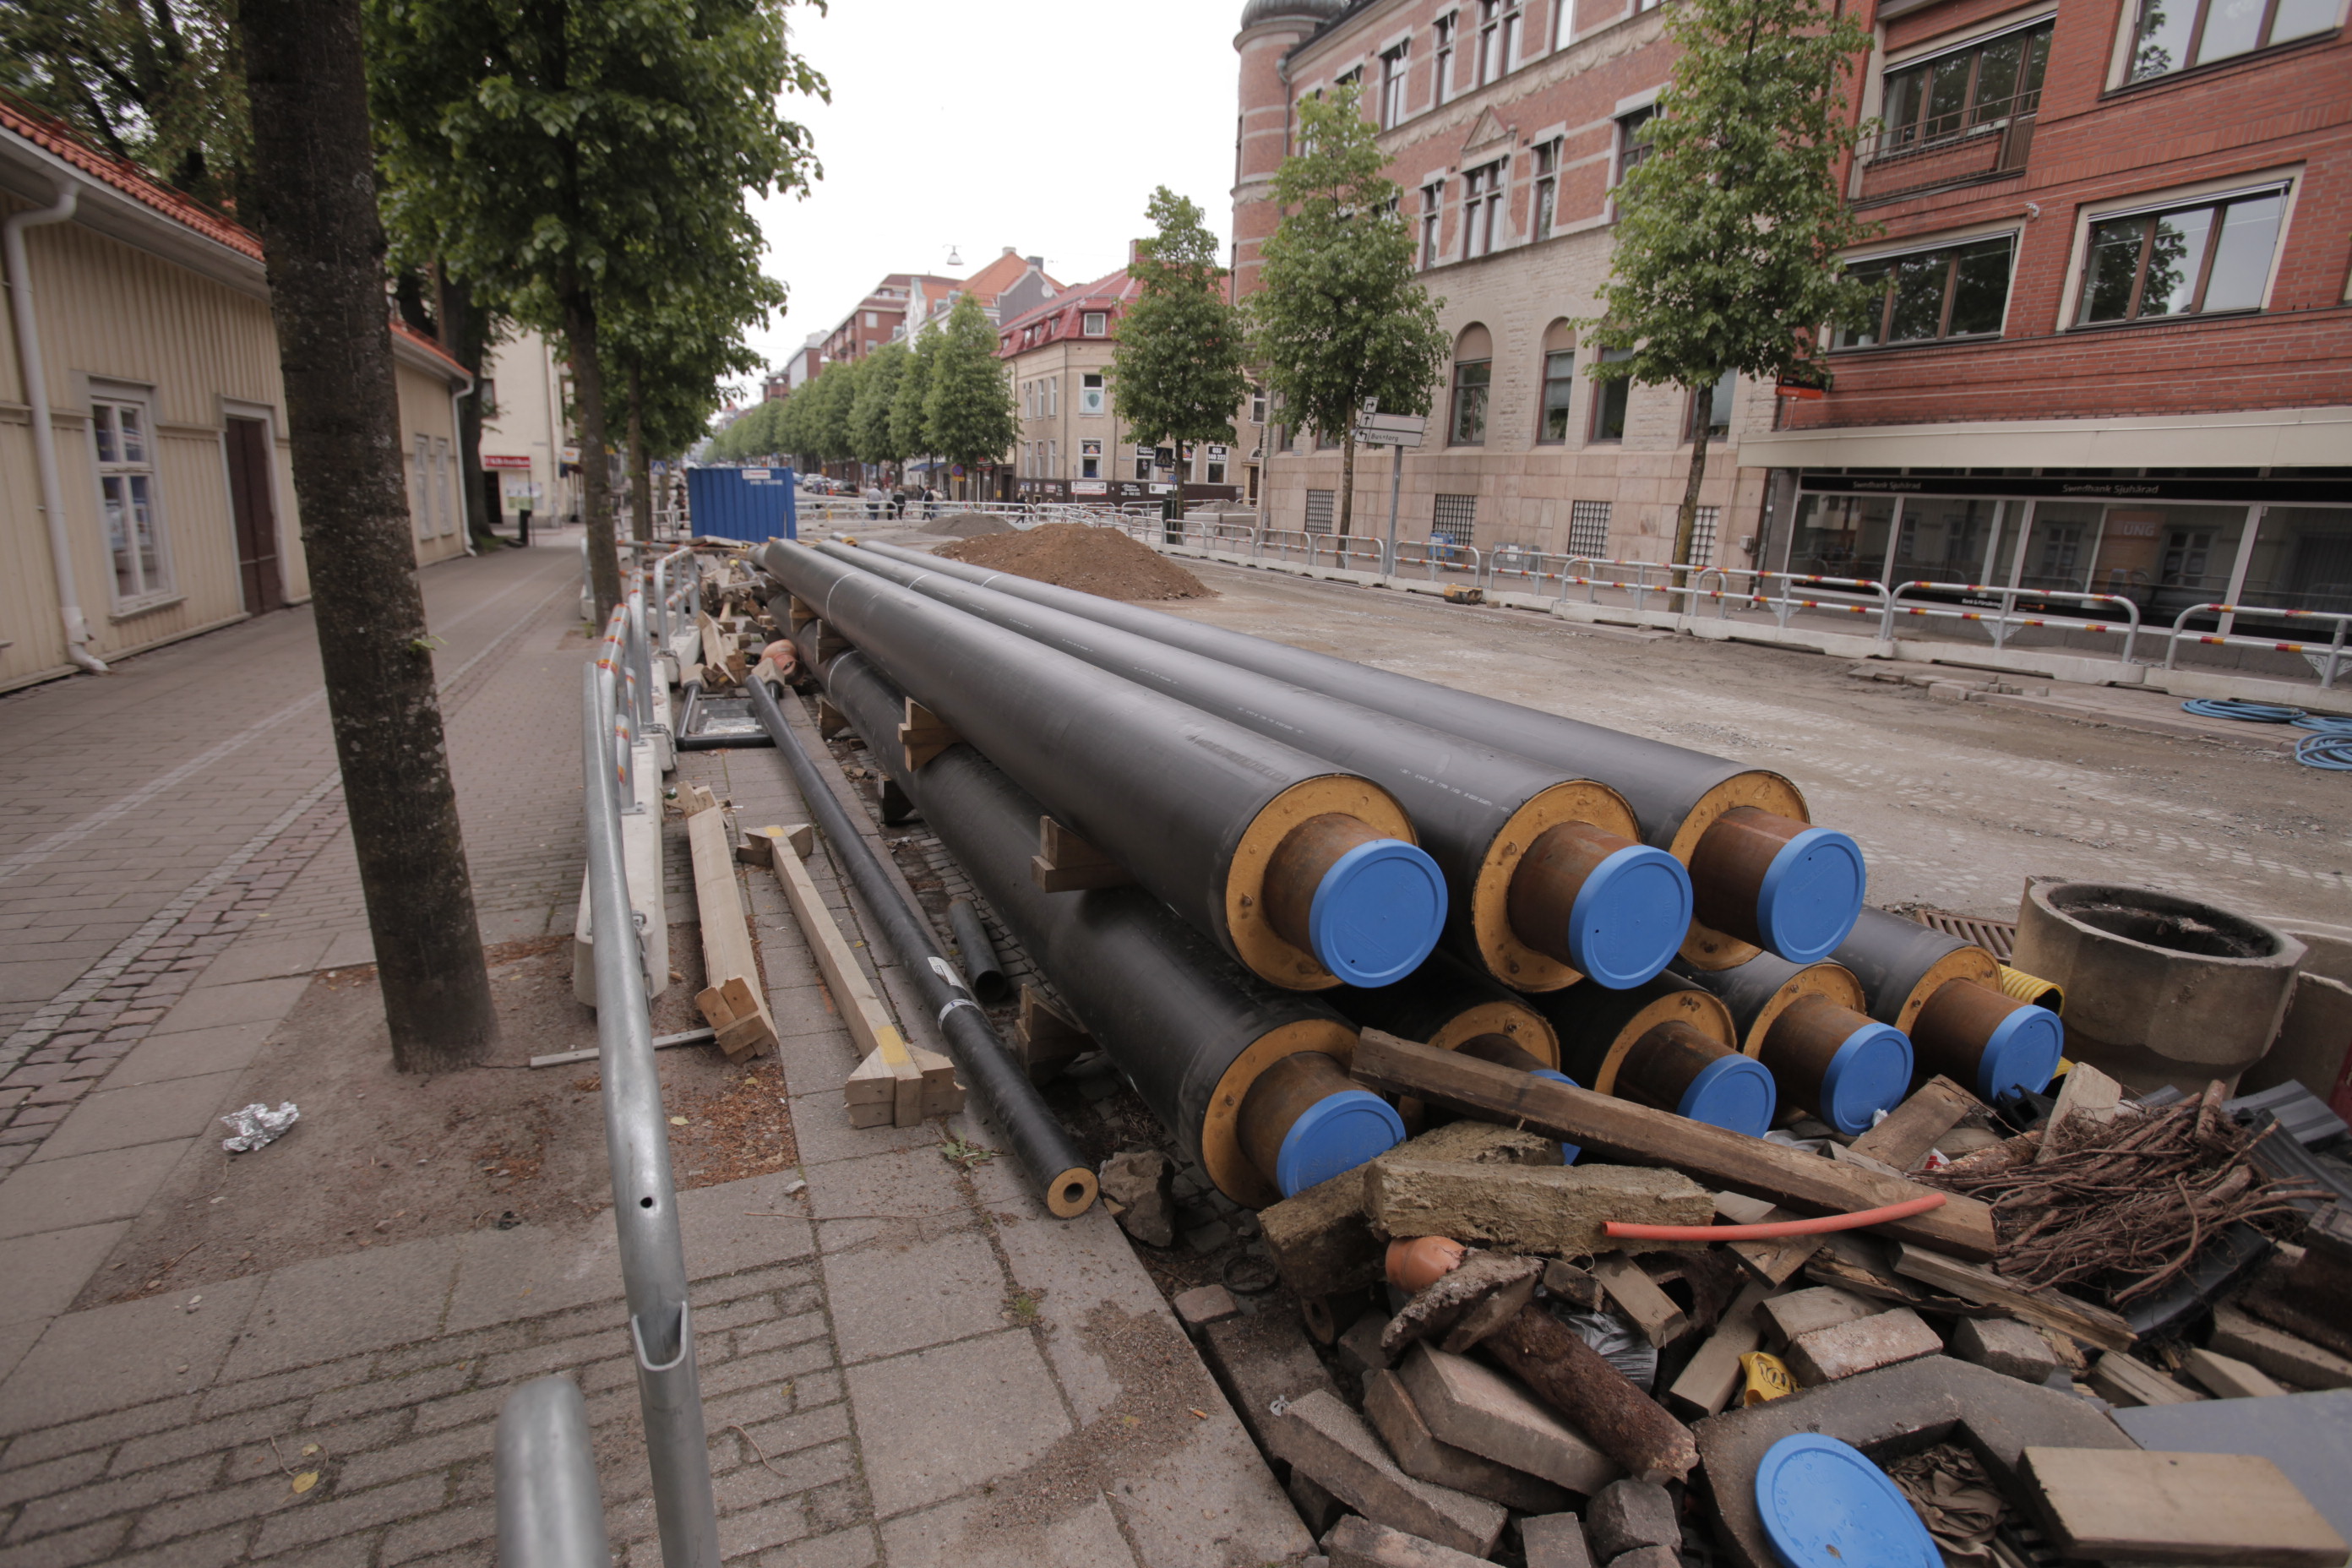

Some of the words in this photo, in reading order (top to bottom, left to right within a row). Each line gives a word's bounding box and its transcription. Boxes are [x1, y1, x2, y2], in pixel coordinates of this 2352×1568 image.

[2062, 483, 2112, 493] Swedbank
[2113, 484, 2159, 495] Sjuhärad
[2122, 524, 2155, 537] UNG
